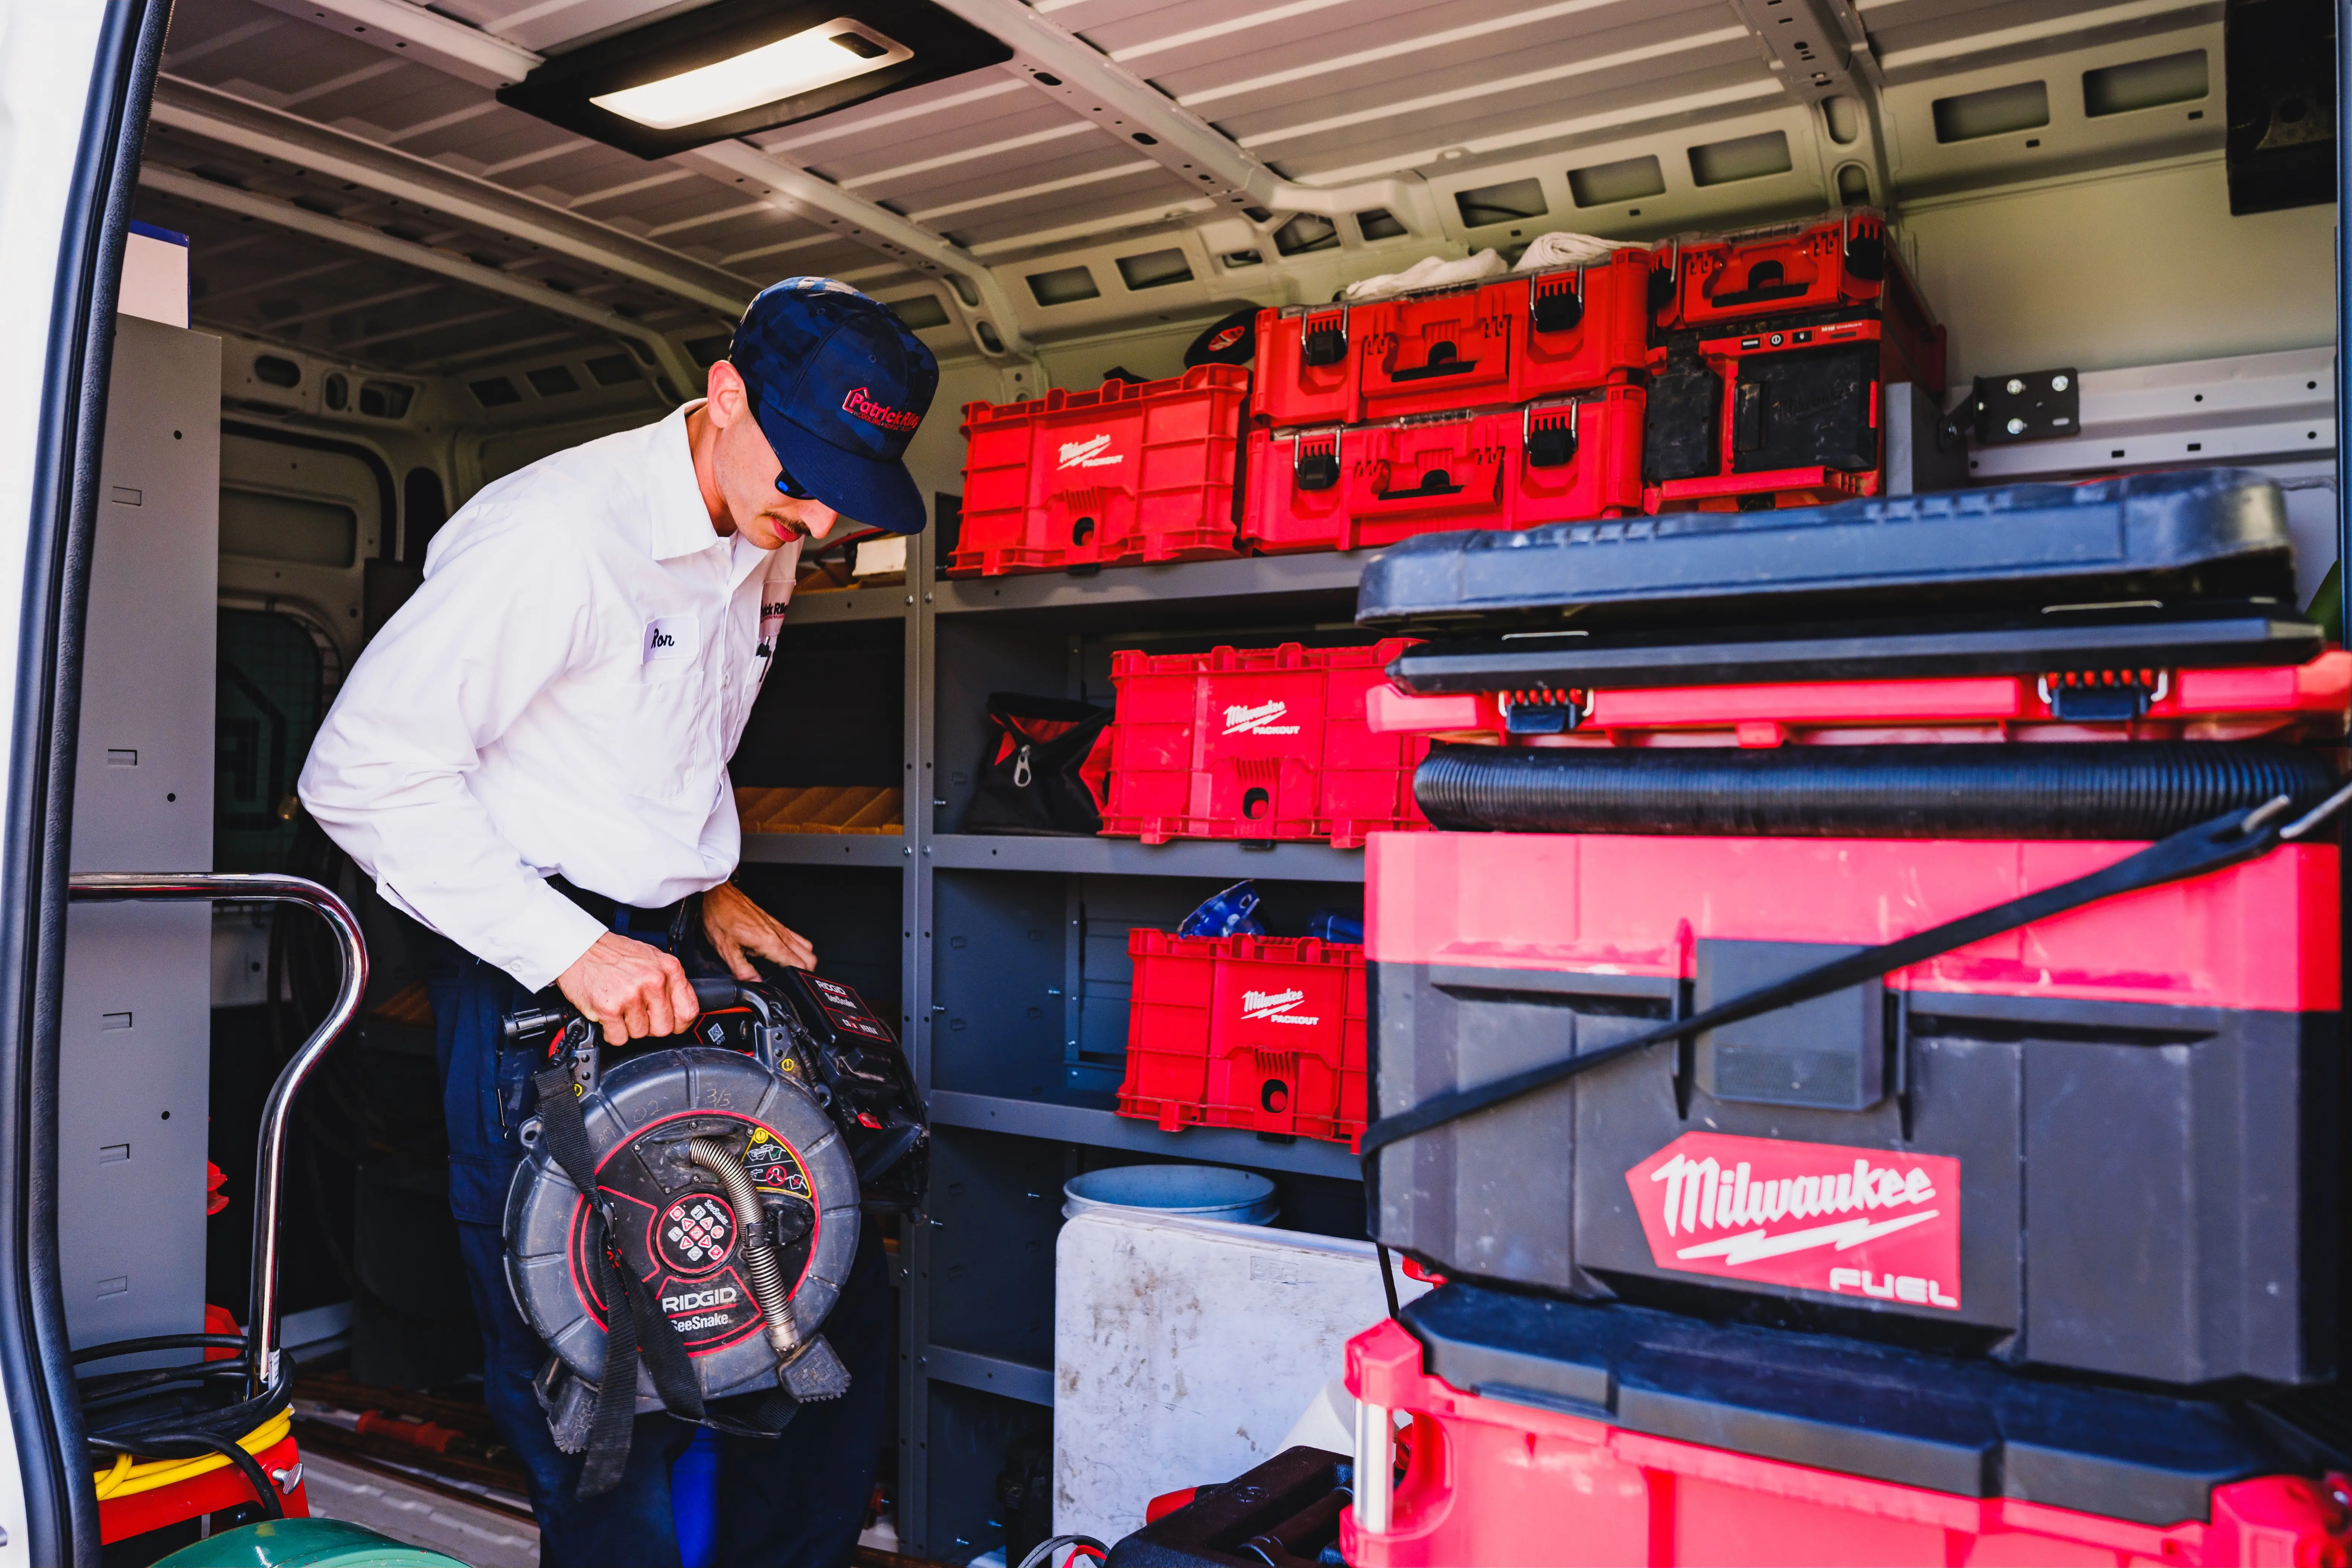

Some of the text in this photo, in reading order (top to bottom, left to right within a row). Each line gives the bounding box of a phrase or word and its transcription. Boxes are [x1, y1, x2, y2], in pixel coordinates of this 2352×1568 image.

[858, 412, 881, 426] COOLING
[651, 628, 675, 649] Ron
[1253, 726, 1300, 735] PACKOUT
[815, 980, 847, 995] RIDGID
[824, 992, 857, 1009] SeeSnake
[1241, 988, 1304, 1012] Milwaukee
[1271, 1014, 1319, 1025] PACKOUT
[1651, 1153, 1936, 1237] Milwaukee
[704, 1199, 729, 1225] SeeSnake
[1830, 1268, 1958, 1307] FUEL
[662, 1287, 737, 1313] RIDGID
